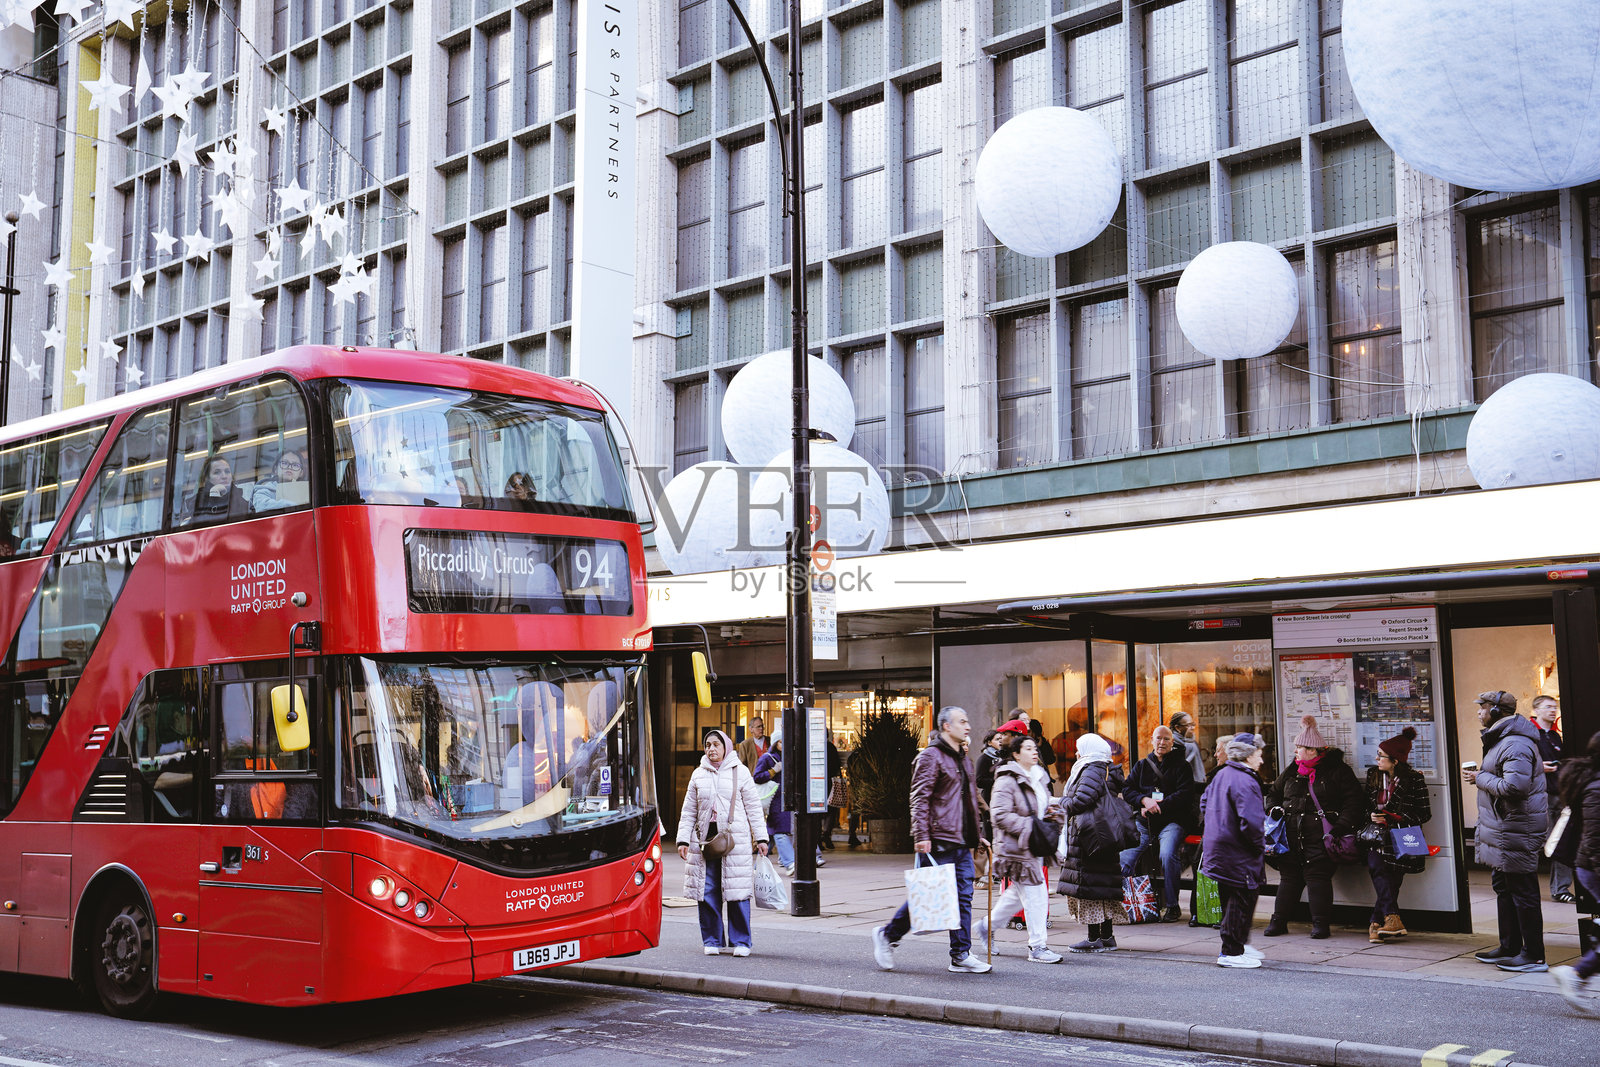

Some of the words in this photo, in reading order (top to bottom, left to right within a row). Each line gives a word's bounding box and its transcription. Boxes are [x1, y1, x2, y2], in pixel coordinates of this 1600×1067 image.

[610, 48, 620, 59] &
[608, 72, 620, 199] PARTNERS
[231, 558, 286, 580] LONDON
[418, 544, 488, 580] Piccadilly
[493, 548, 535, 574] Circus
[575, 548, 613, 588] 94
[231, 579, 286, 600] UNITED
[231, 603, 251, 614] RATP
[262, 598, 286, 610] GROUP
[246, 845, 260, 860] 361
[505, 886, 546, 899] LONDON
[550, 881, 584, 892] UNITED
[506, 899, 536, 912] RATP
[552, 891, 584, 905] GROUP
[518, 948, 550, 967] LB69
[553, 943, 575, 960] JPJ
